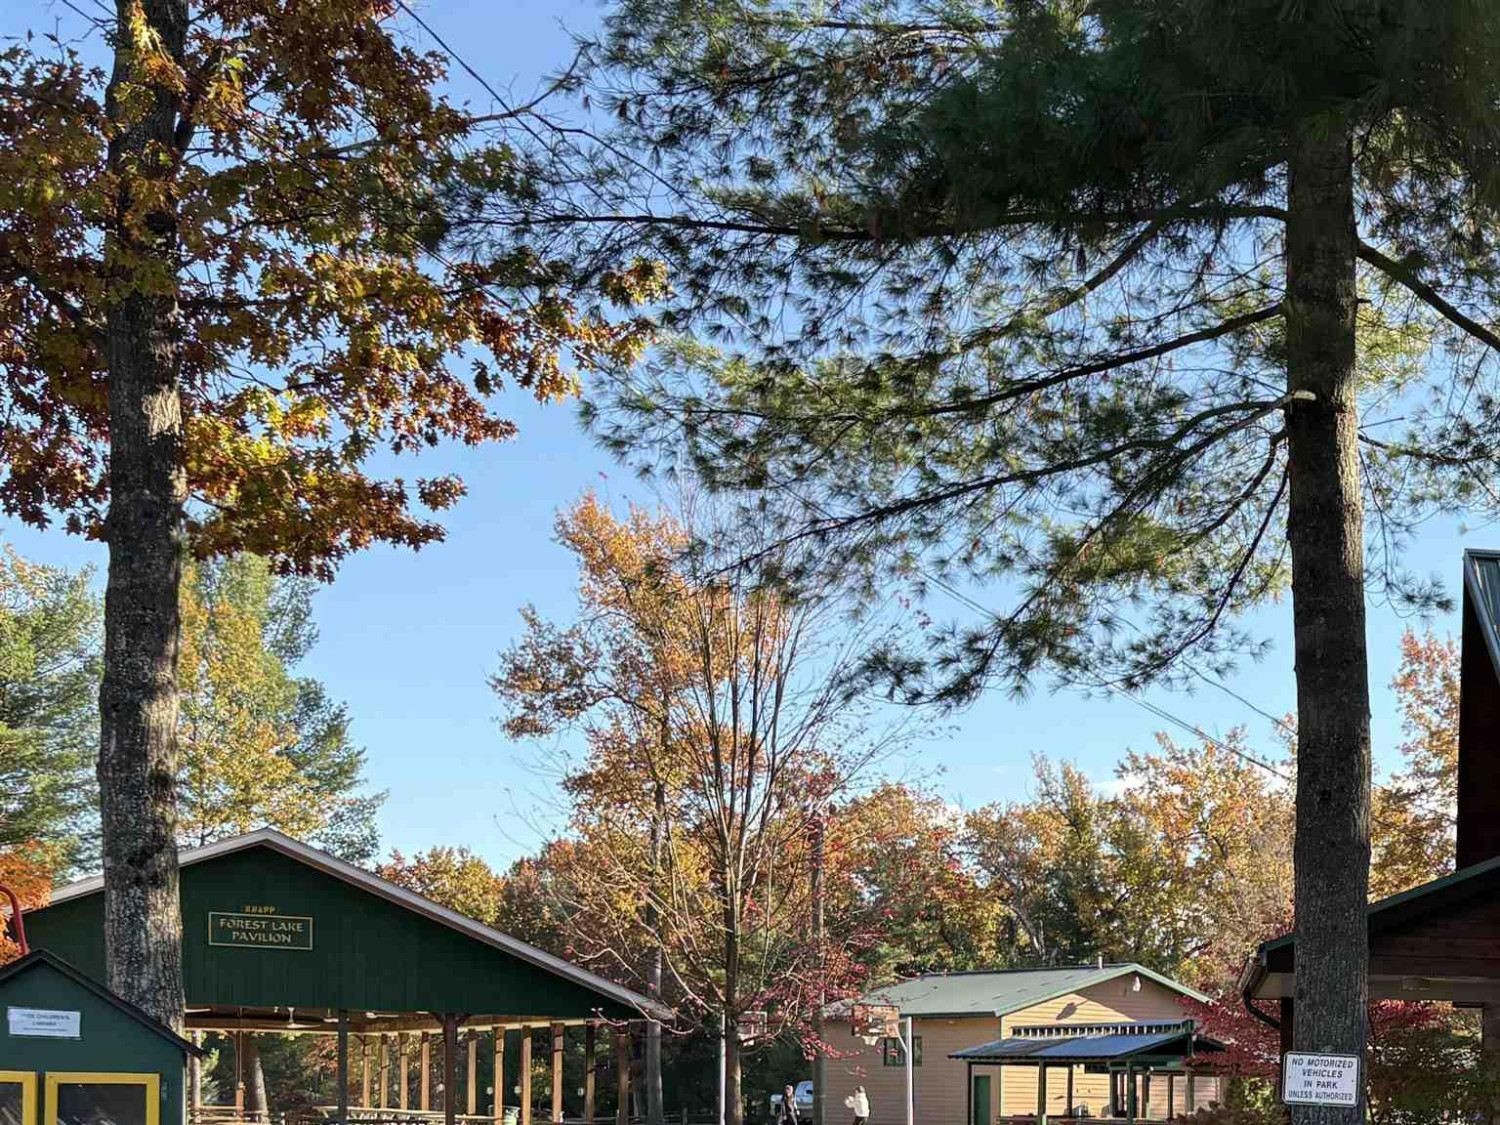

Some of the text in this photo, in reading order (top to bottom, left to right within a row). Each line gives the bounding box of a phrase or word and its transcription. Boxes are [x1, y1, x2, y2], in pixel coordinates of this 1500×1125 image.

[219, 918, 304, 932] FOREST LAKE
[232, 931, 292, 943] PAVILION
[1292, 1058, 1354, 1069] NO MOTORIZED
[1302, 1069, 1344, 1078] VEHICLES
[1316, 1081, 1338, 1089] PARK
[1288, 1090, 1354, 1101] UNLESS AUTHORIZED
